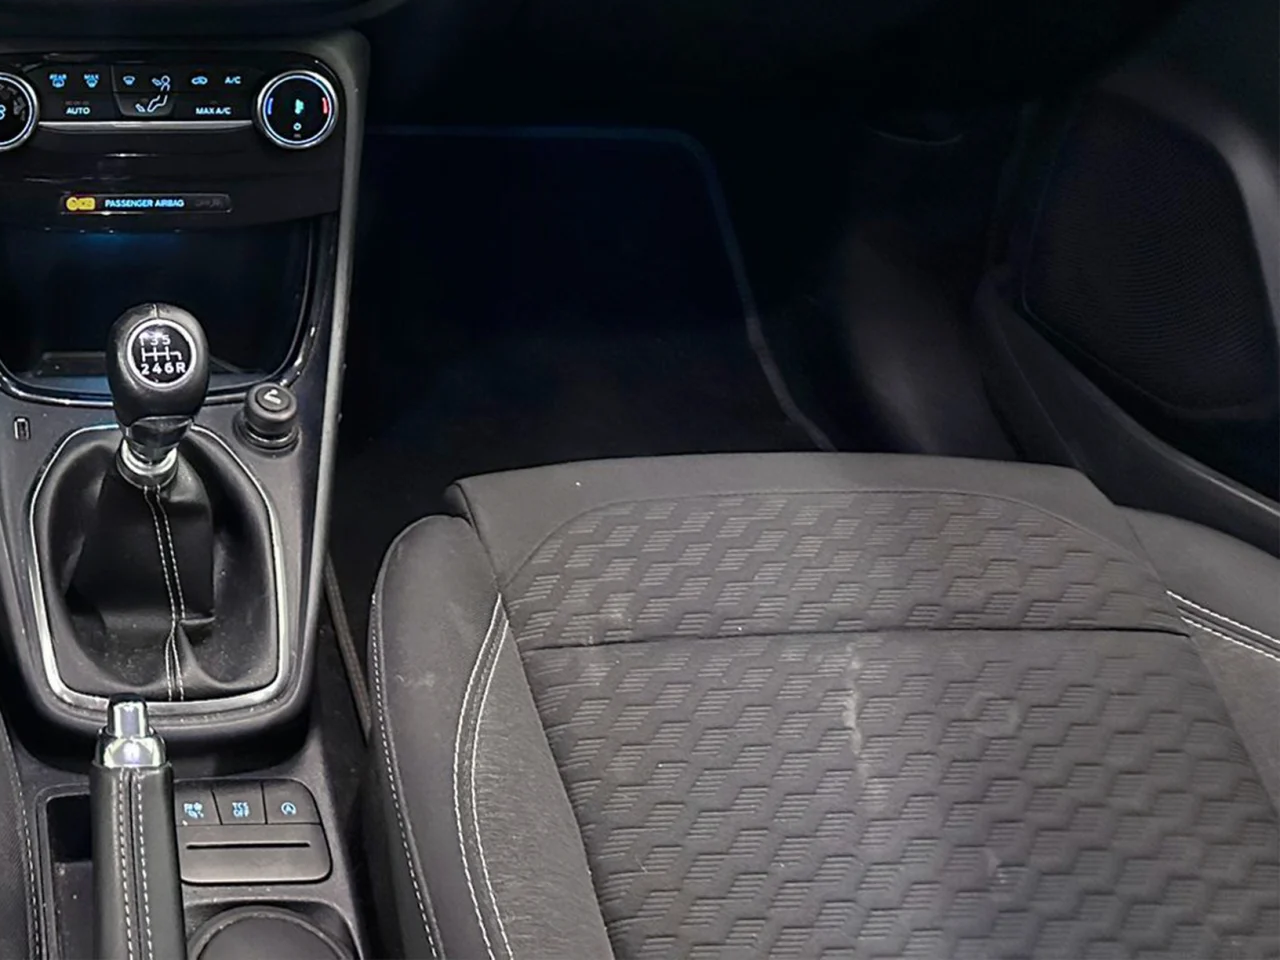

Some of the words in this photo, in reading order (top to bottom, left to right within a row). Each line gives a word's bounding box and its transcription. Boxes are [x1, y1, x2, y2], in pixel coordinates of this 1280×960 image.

[225, 76, 241, 84] A/C
[66, 107, 90, 115] AUTO
[196, 107, 214, 115] MAX
[215, 107, 231, 115] A/C
[104, 199, 153, 208] PASSENGER
[155, 199, 185, 208] AIRBAG
[162, 335, 171, 346] 5
[141, 363, 150, 375] 2
[152, 363, 162, 374] 4
[164, 362, 175, 374] 6
[176, 362, 186, 373] R
